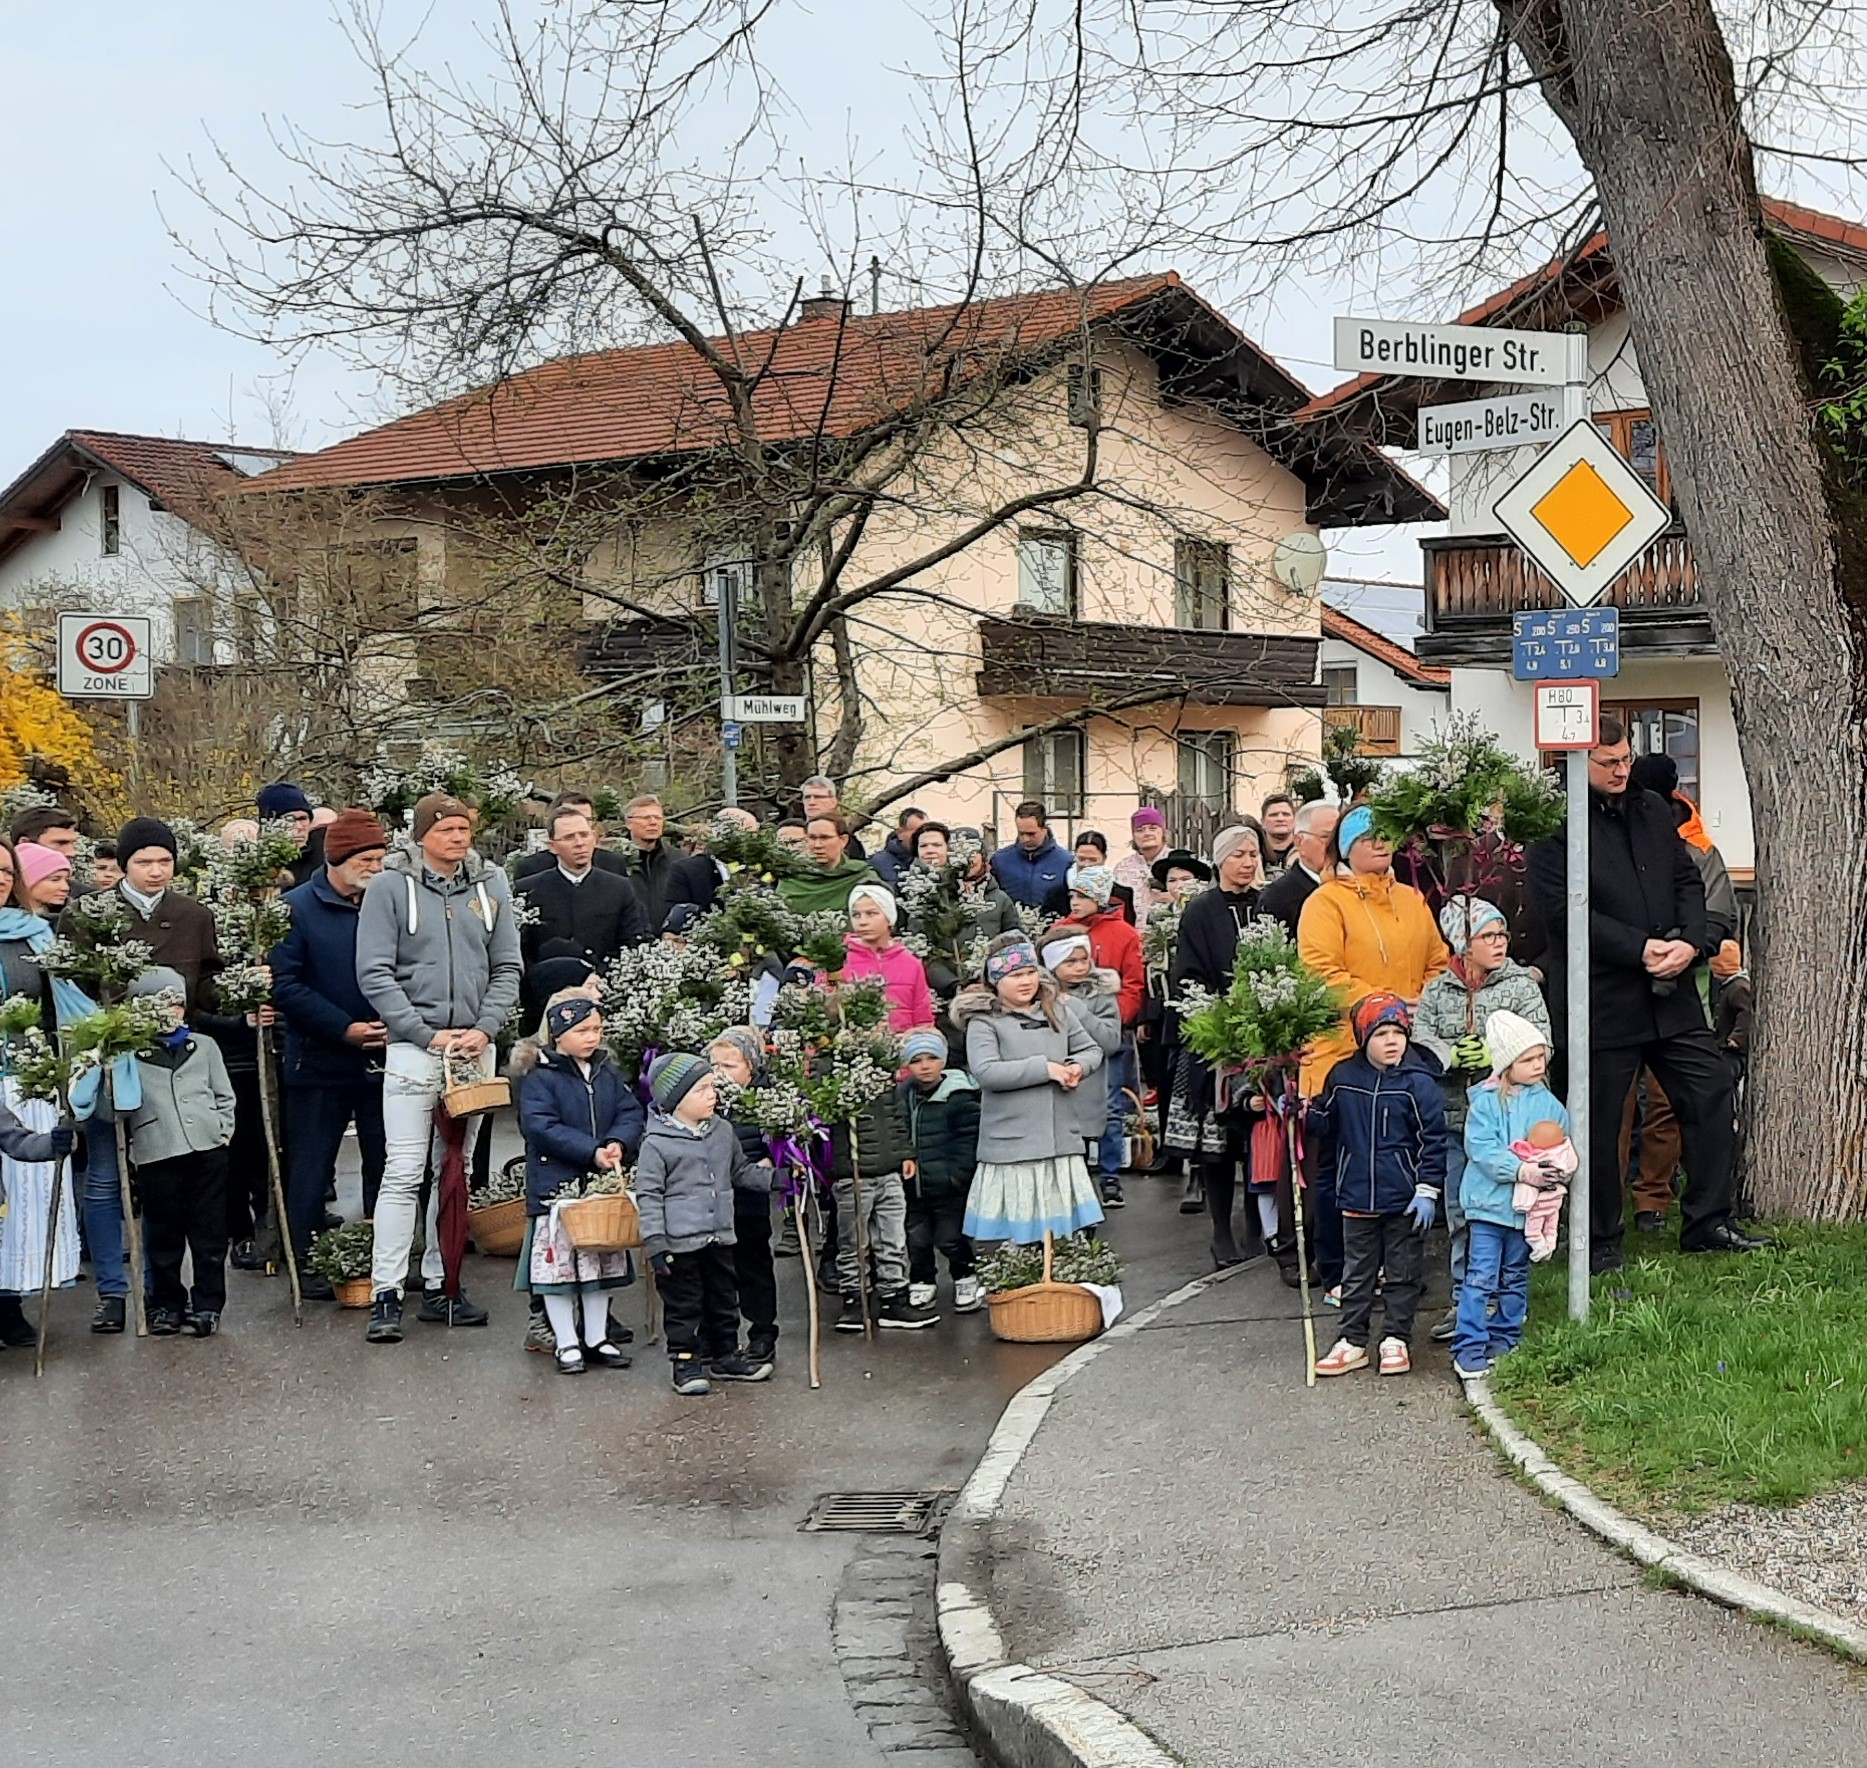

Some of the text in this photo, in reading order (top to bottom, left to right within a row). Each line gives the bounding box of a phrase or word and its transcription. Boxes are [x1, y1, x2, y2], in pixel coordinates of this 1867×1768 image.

[1359, 328, 1546, 375] Berblinger Str.
[1424, 403, 1560, 450] Eugen-Belz-Str.
[88, 636, 122, 660] 30
[83, 676, 129, 691] ZONE
[743, 699, 797, 718] Mühlweg
